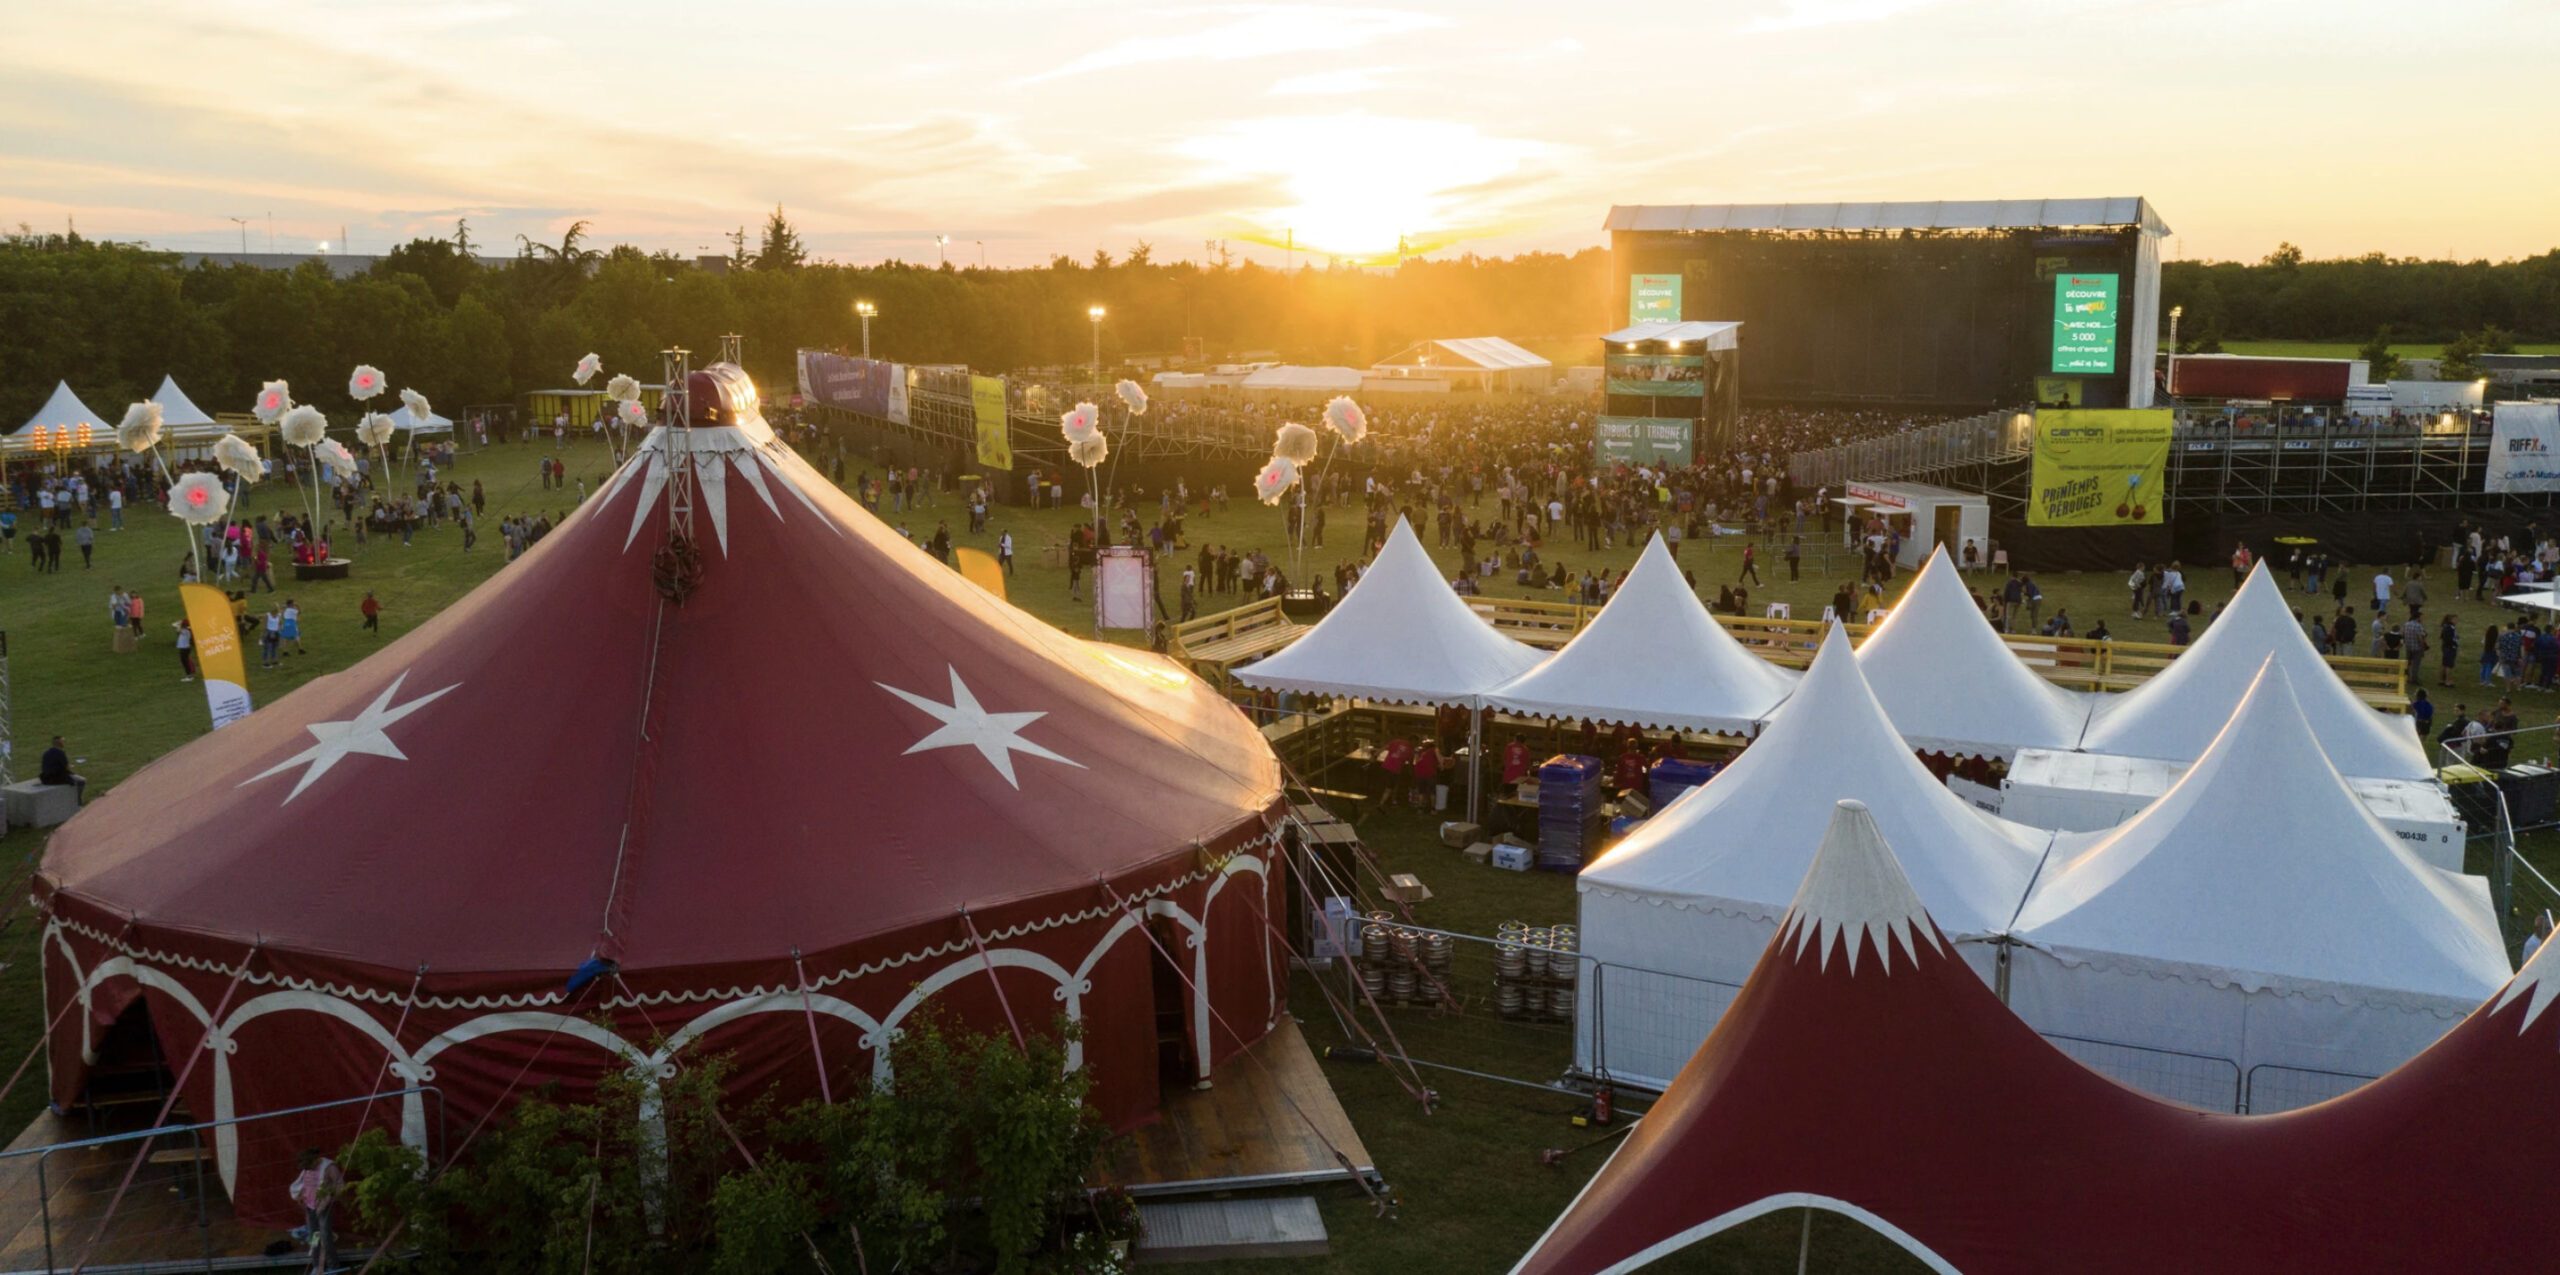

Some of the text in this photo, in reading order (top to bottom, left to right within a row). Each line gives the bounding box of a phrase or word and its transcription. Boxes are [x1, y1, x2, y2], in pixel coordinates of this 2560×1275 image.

[2066, 290, 2107, 298] DÉCOUVRE
[2072, 333, 2096, 341] 5 000
[1599, 424, 1632, 438] TRIBUNE
[1647, 425, 1689, 440] TRIBUNE A
[2048, 492, 2103, 519] PÉROUGES
